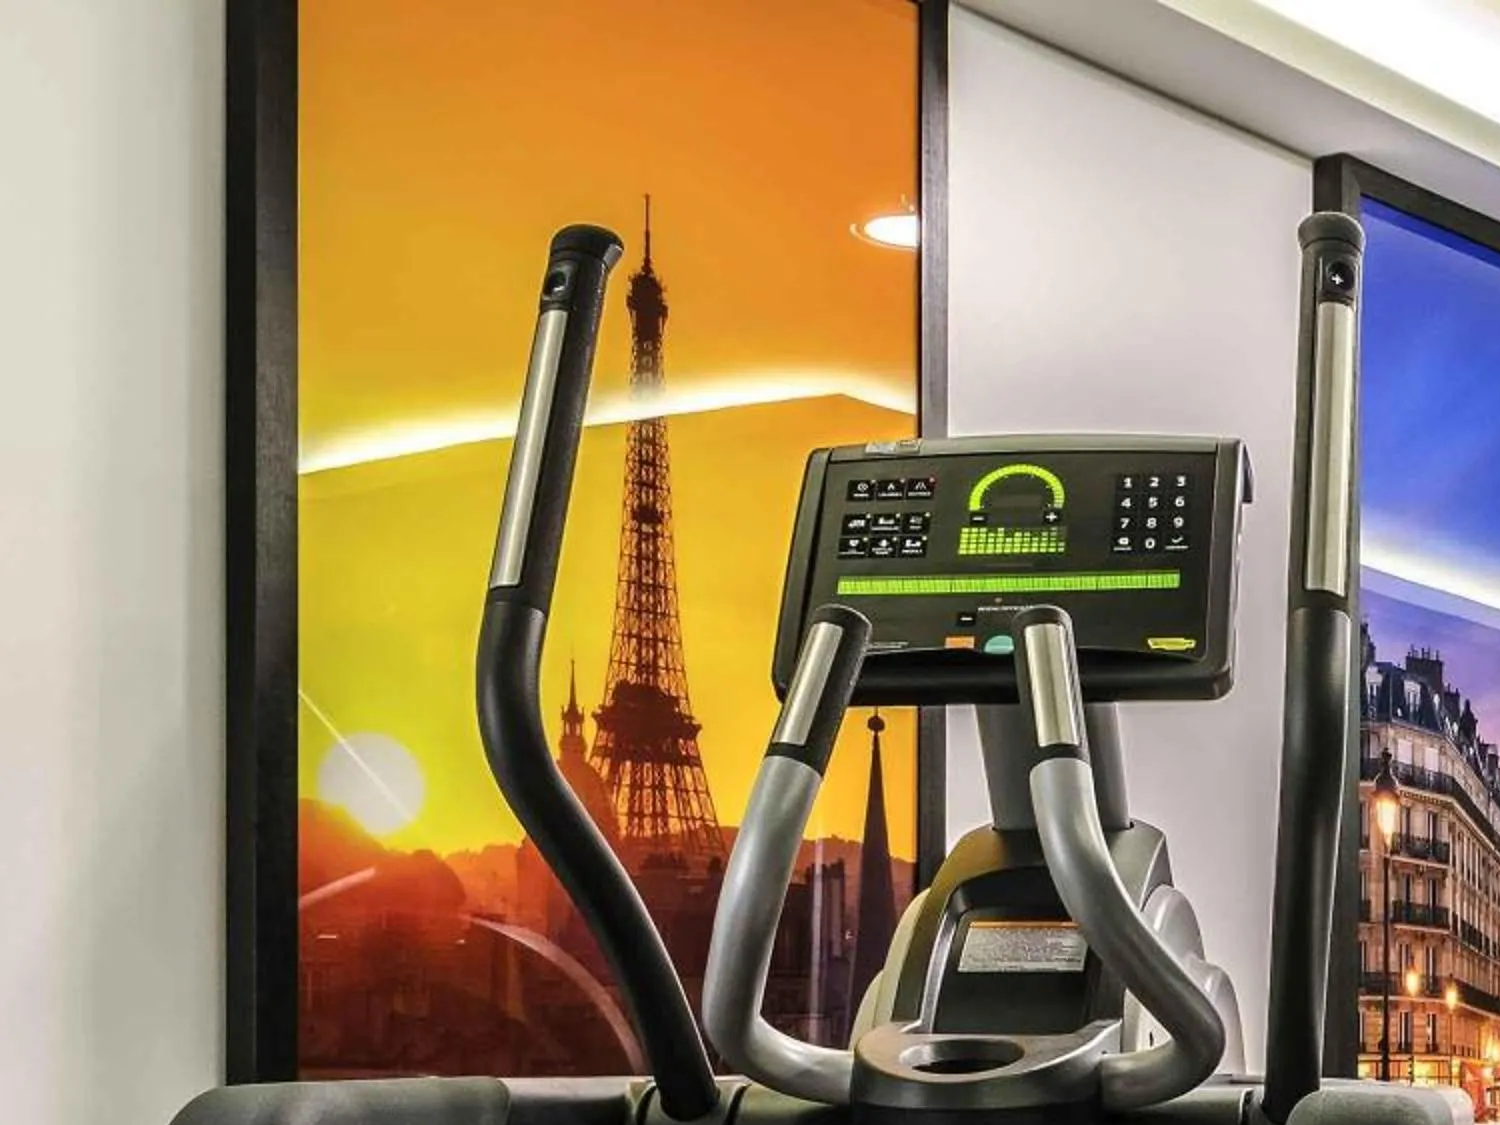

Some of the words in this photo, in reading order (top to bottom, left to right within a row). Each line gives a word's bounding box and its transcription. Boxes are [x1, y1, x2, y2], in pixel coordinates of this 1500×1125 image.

[1123, 476, 1133, 489] 1
[1149, 476, 1159, 488] 2
[1176, 475, 1186, 487] 3
[1121, 497, 1131, 508] 4
[1148, 496, 1158, 509] 5
[1175, 496, 1185, 507] 6
[1120, 517, 1130, 529] 7
[1146, 517, 1157, 529] 8
[1173, 516, 1184, 528] 9
[1145, 537, 1155, 549] 0
